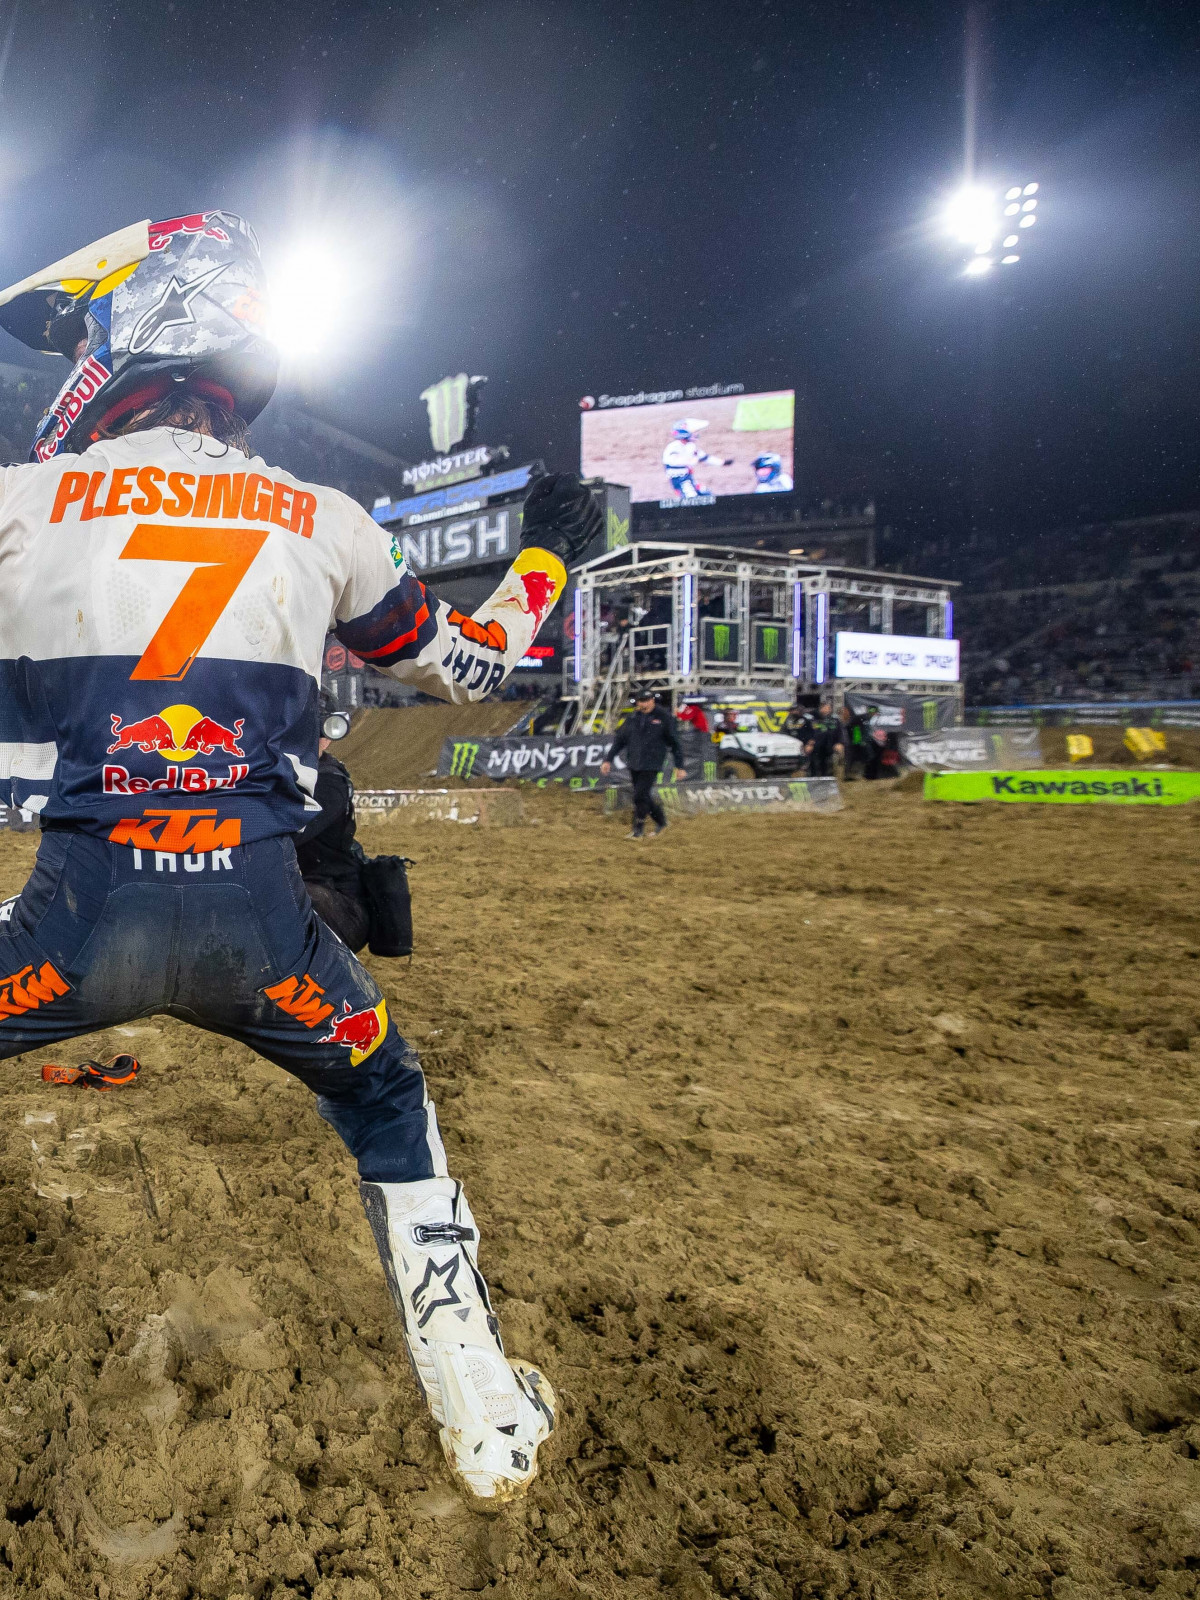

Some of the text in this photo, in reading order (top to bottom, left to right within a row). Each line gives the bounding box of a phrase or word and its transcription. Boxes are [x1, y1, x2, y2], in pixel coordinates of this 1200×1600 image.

[402, 446, 490, 484] MONSTER
[49, 465, 318, 539] PLESSINGER
[400, 511, 510, 571] NISH
[118, 524, 271, 681] 7
[102, 763, 249, 794] Red Bull
[991, 776, 1164, 797] Kawasaki
[109, 809, 241, 853] KTM
[133, 848, 233, 873] THOR
[264, 973, 335, 1029] KTM
